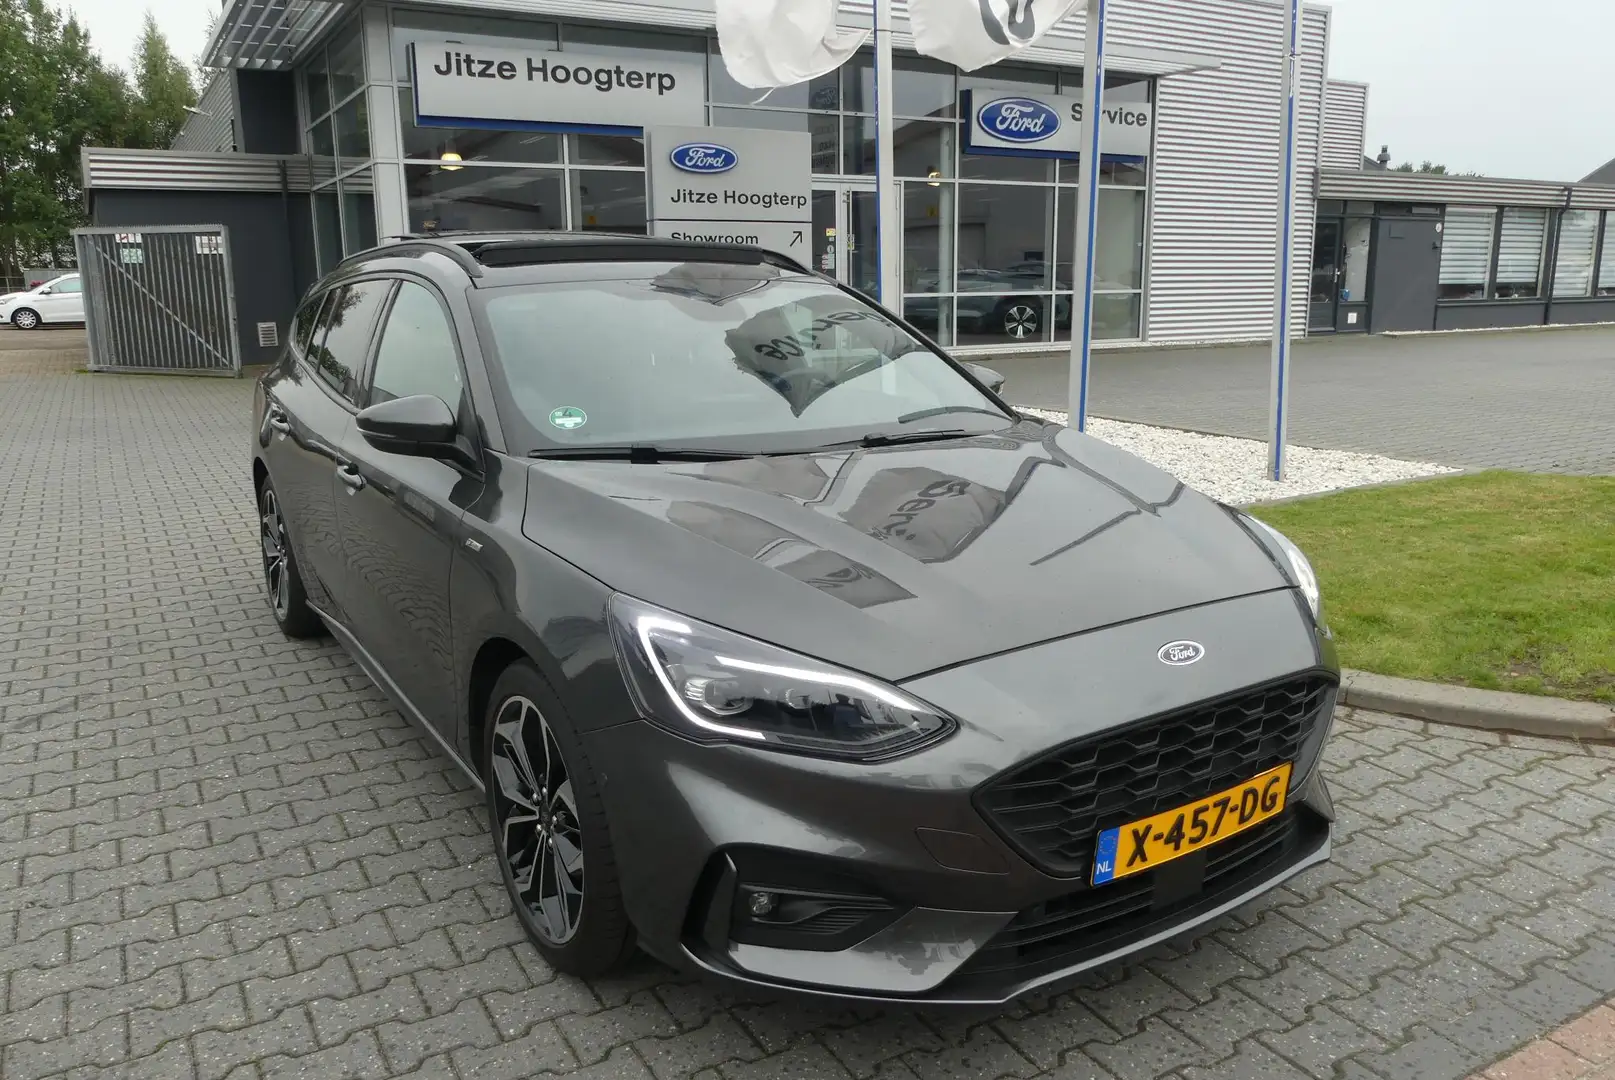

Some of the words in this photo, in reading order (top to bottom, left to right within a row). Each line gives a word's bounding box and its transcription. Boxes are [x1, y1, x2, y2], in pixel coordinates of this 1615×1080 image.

[434, 51, 517, 80] Jitze
[526, 57, 676, 95] Hoogterp
[995, 103, 1046, 133] Ford
[1071, 102, 1148, 127] Svice
[684, 147, 727, 168] Ford
[670, 188, 718, 204] Jitze
[723, 189, 808, 209] Hoogterp
[1126, 775, 1281, 868] X-457-DG
[1095, 860, 1113, 876] NL
